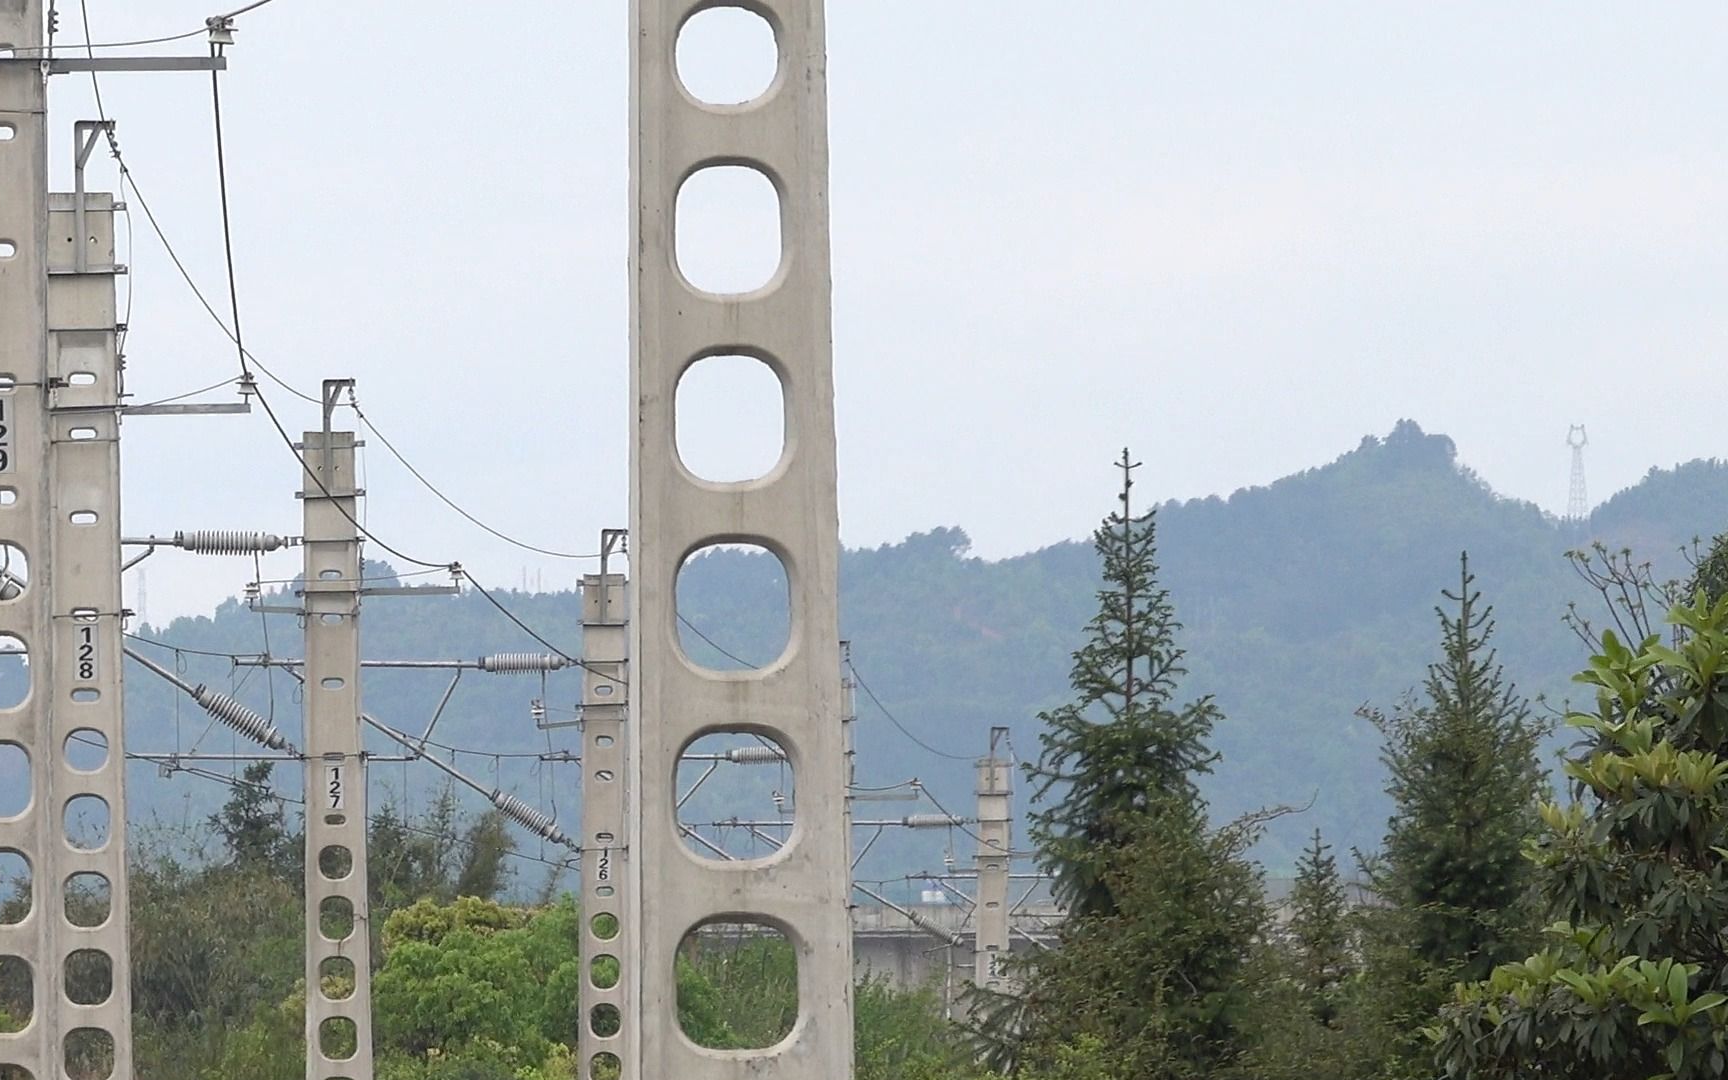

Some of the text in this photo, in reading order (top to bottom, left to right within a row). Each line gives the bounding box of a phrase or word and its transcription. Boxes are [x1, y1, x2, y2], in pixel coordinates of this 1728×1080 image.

[79, 626, 94, 679] 128
[329, 767, 341, 809] 127
[599, 847, 609, 881] 126
